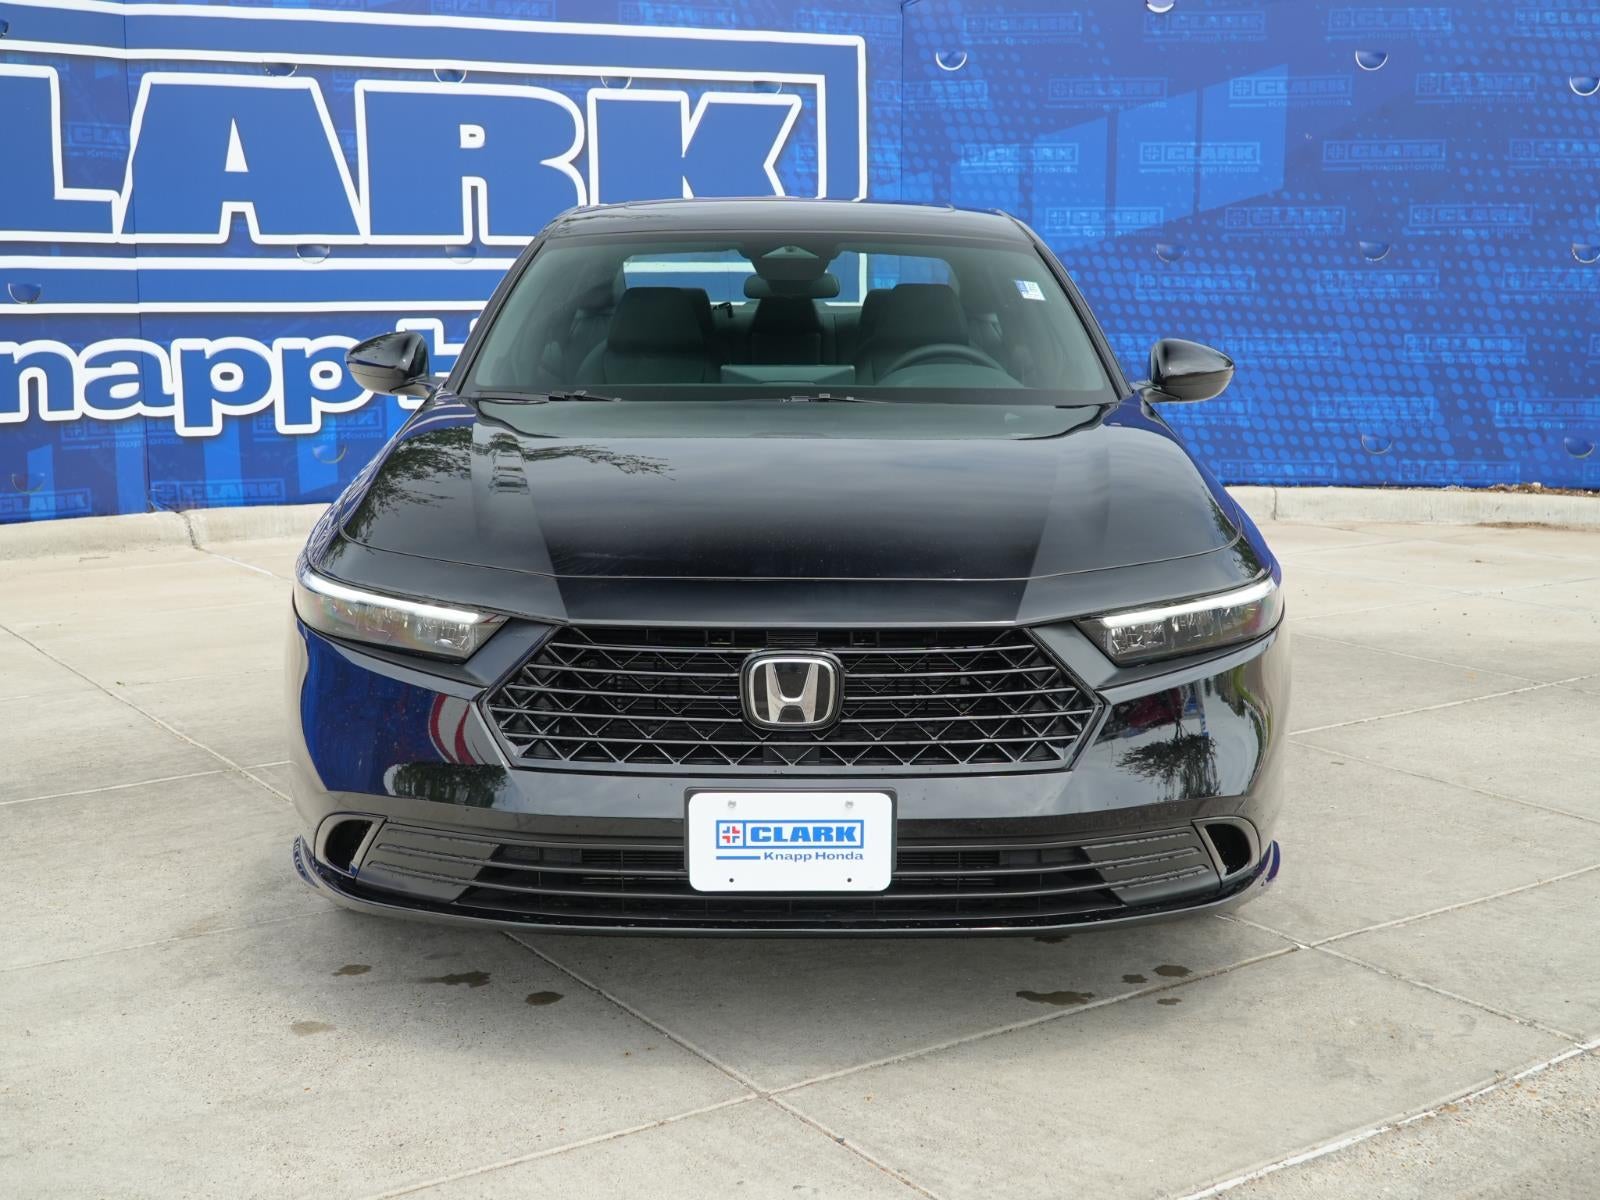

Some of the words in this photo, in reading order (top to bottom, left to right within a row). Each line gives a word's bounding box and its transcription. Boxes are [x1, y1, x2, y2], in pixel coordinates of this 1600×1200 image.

[750, 826, 857, 842] CLARK
[764, 852, 812, 862] Knapp
[815, 852, 864, 860] Honda
